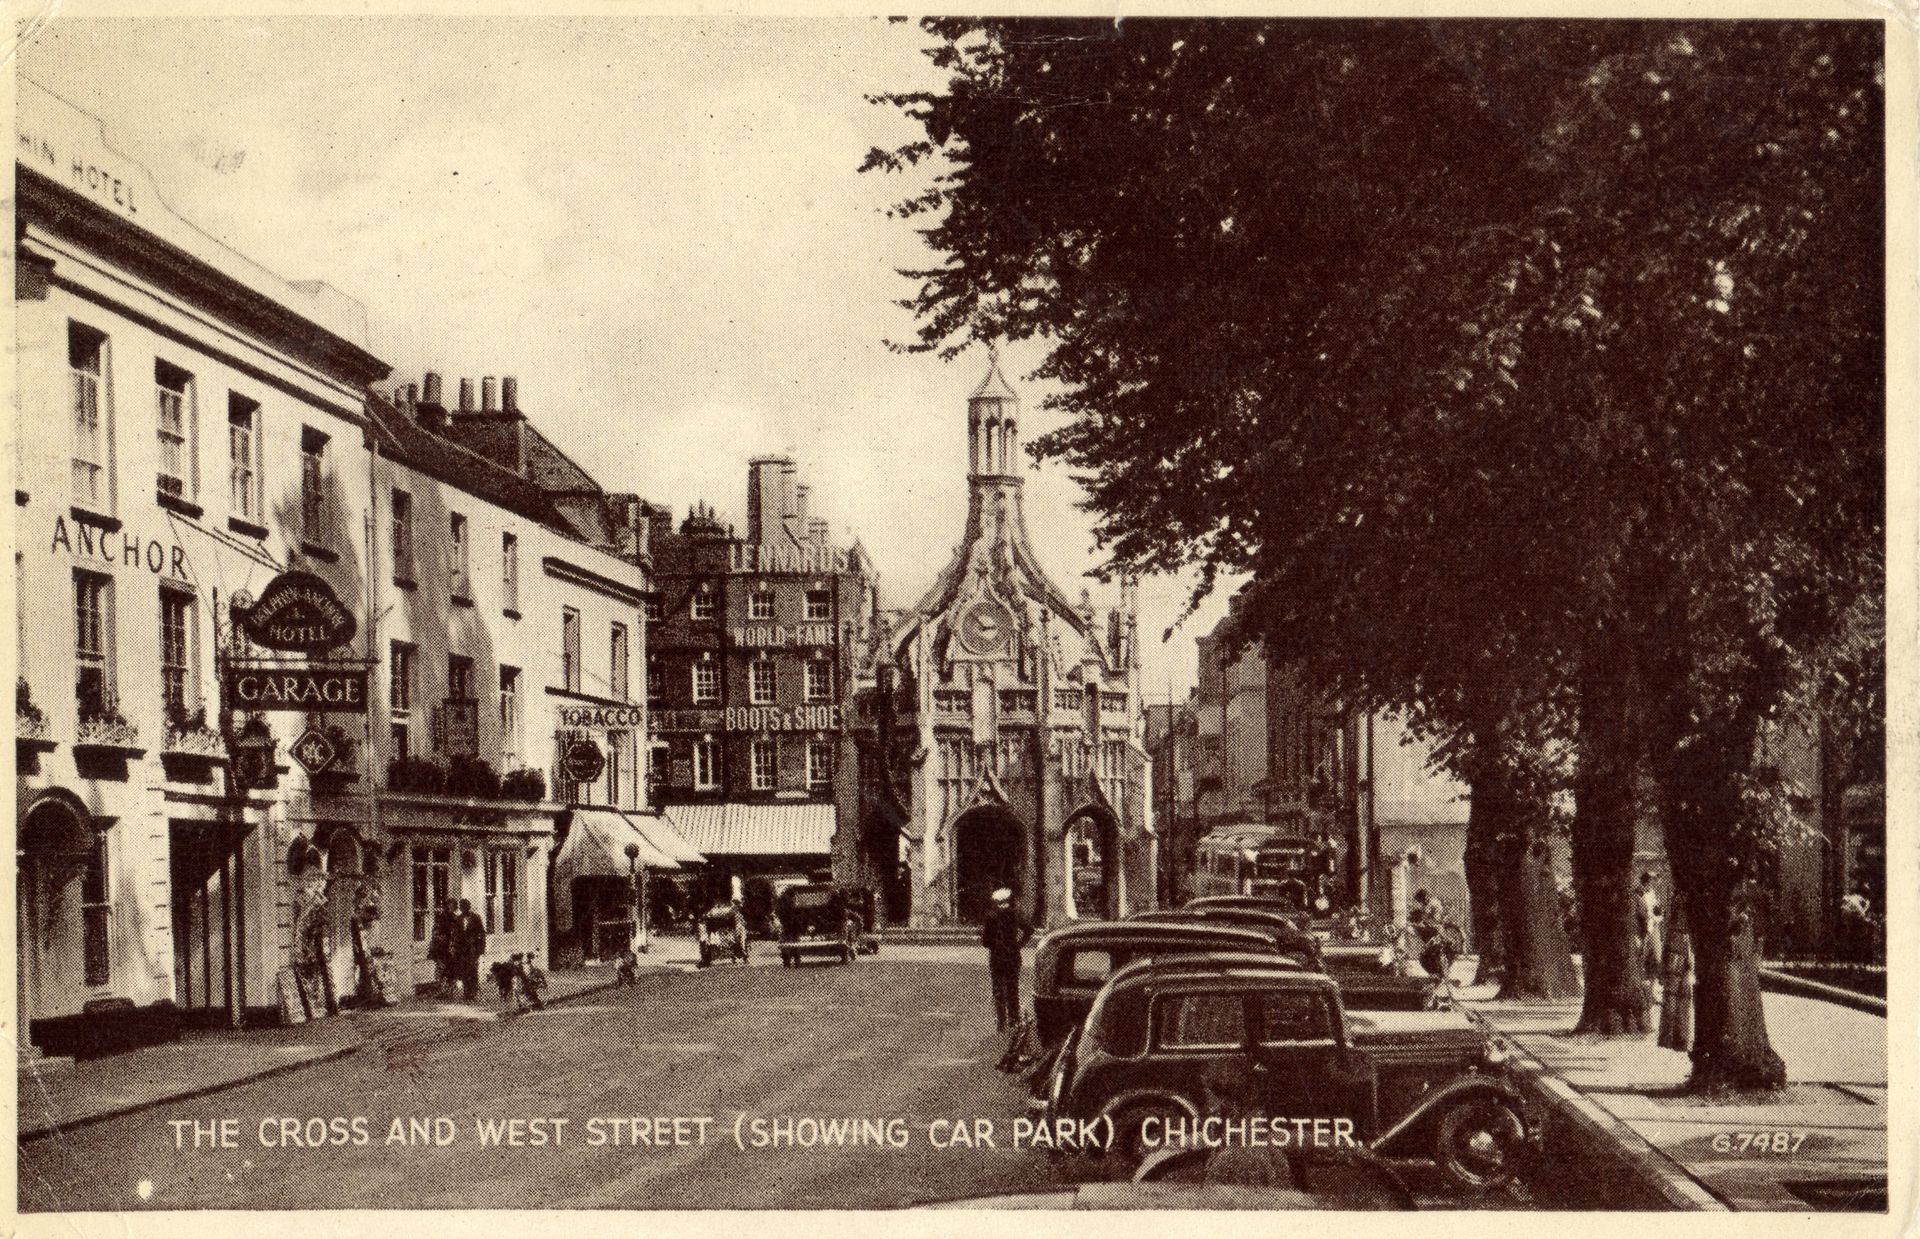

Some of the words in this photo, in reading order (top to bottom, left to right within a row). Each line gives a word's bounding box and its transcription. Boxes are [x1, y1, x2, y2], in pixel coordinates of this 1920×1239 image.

[71, 155, 138, 213] HOTEL
[51, 514, 188, 580] ANCHOR
[269, 624, 331, 643] HOTEL
[237, 676, 360, 703] GARAGE
[561, 709, 643, 726] TOBACCO
[725, 706, 781, 731] BOOTS
[783, 712, 793, 731] &
